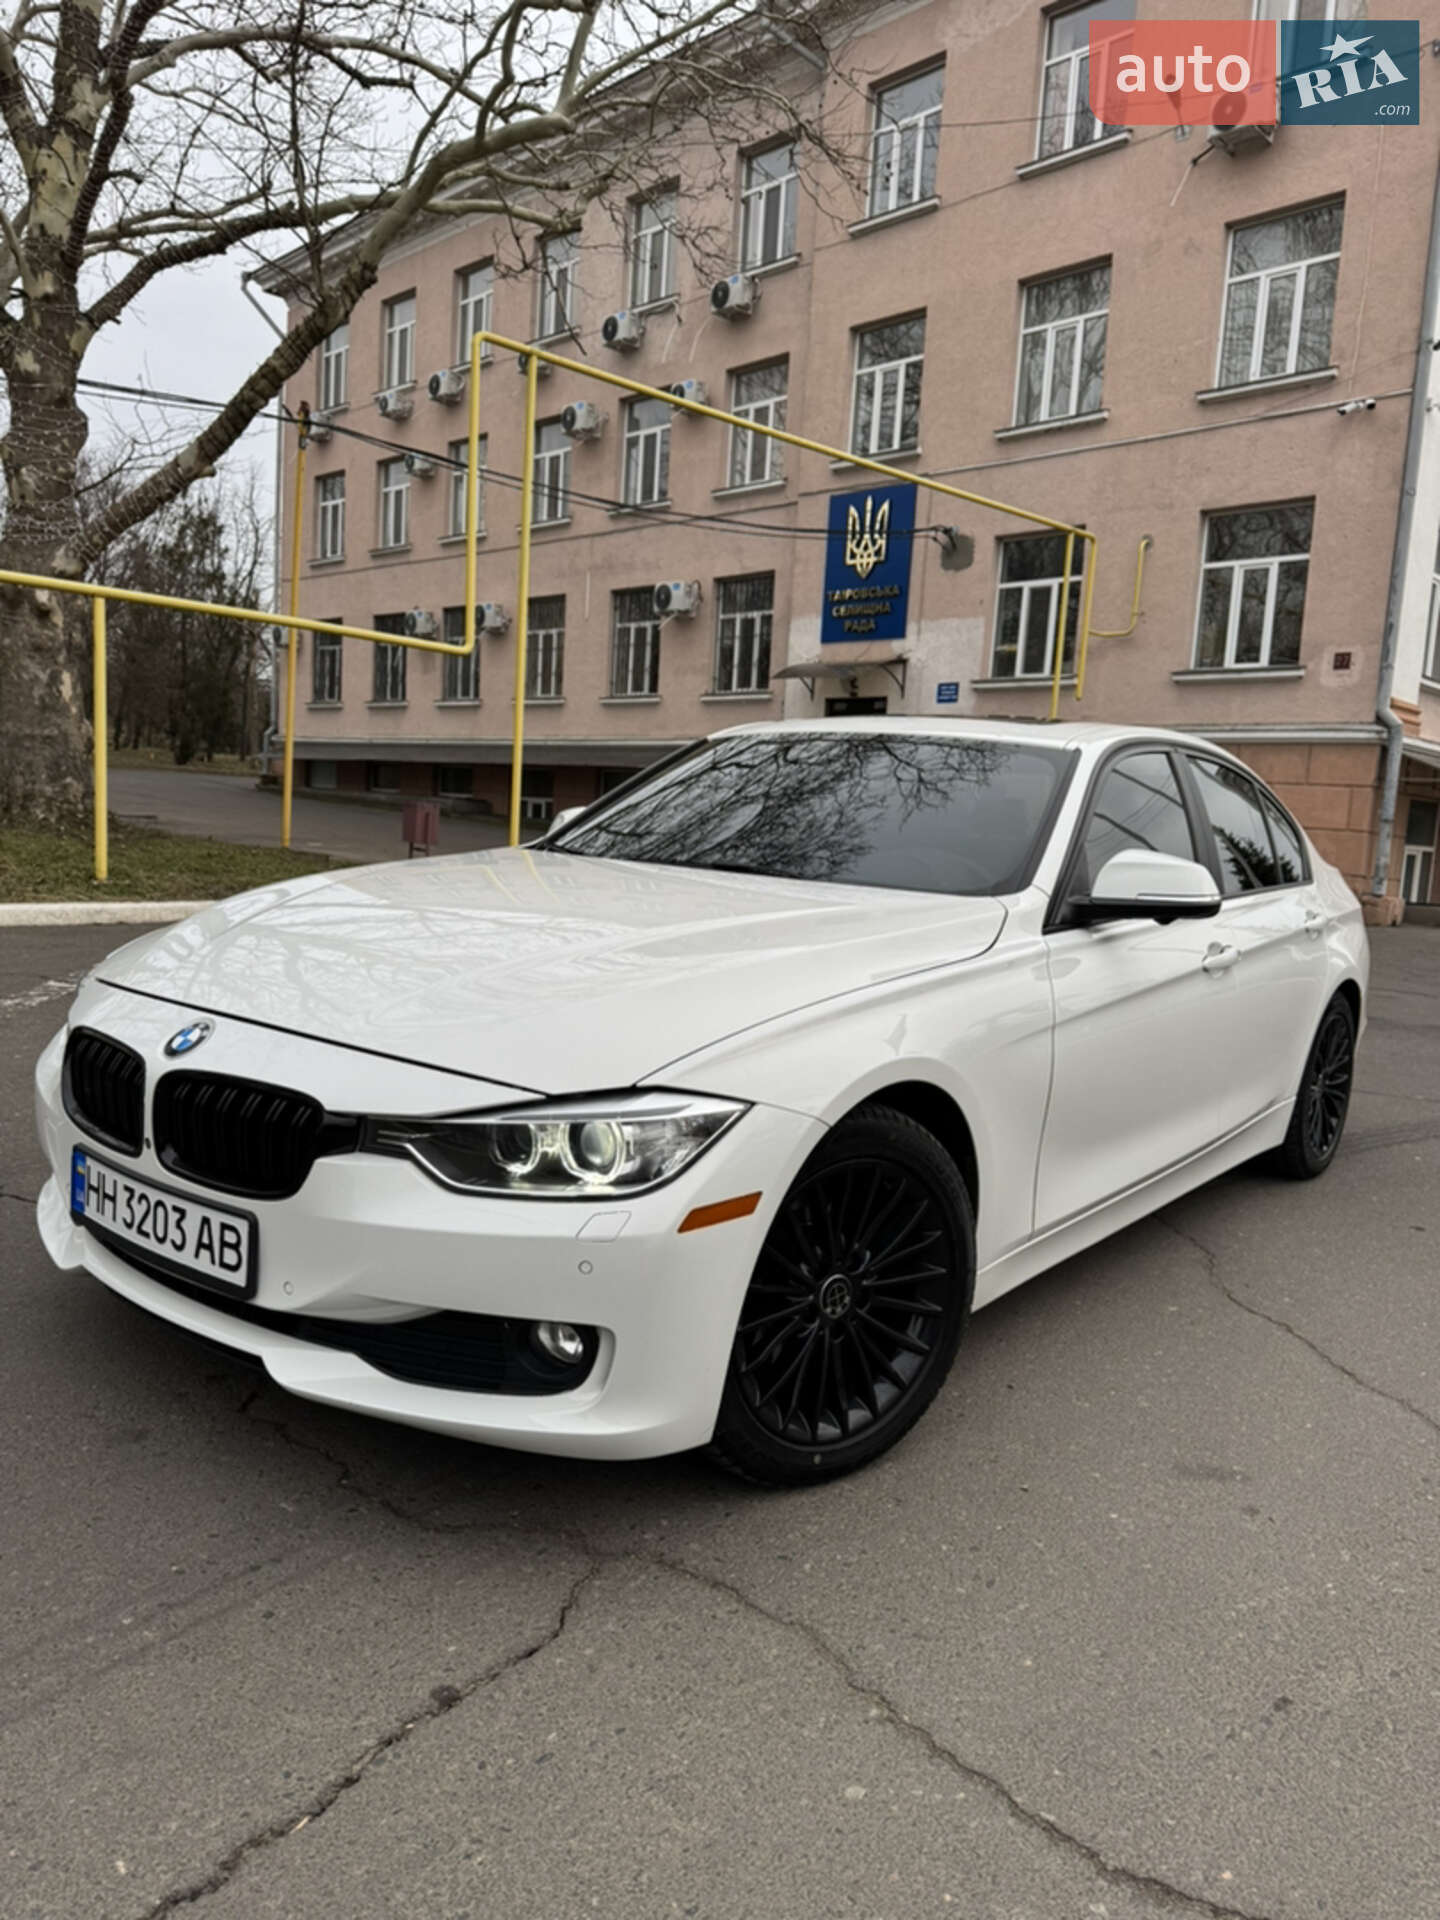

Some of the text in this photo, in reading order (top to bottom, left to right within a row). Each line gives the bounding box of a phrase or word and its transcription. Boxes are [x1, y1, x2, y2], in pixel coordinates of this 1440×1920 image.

[843, 618, 876, 633] РАДА
[86, 1165, 243, 1273] HH 3203 AB
